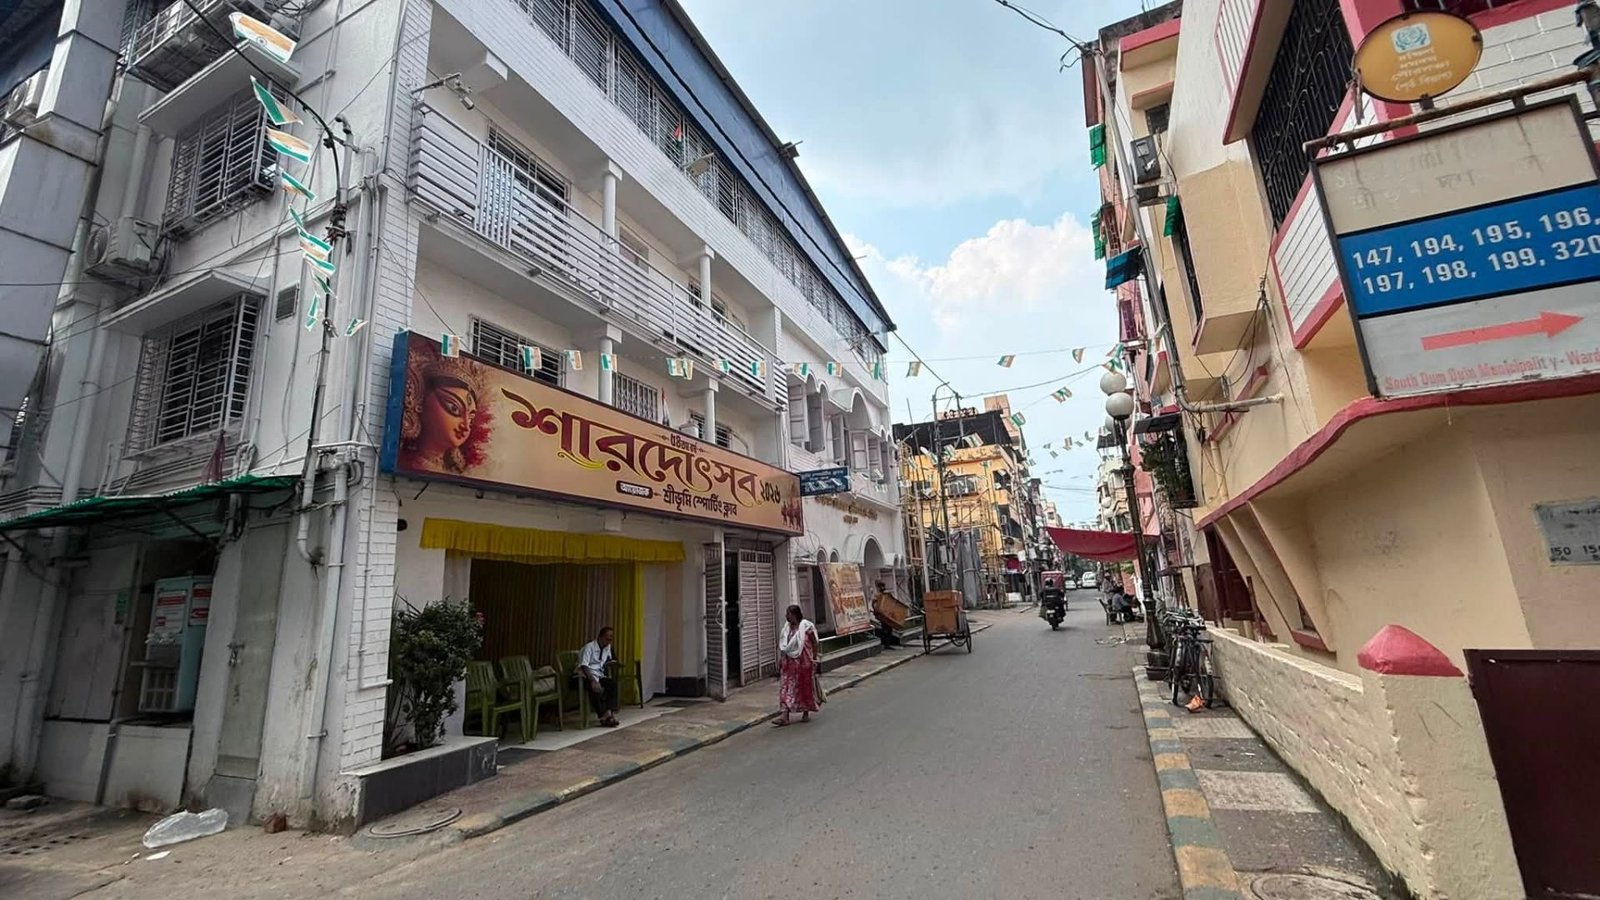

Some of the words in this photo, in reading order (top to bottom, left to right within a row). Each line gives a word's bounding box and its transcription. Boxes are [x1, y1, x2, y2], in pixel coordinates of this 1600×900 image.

[1352, 246, 1403, 270] 147,
[1410, 234, 1464, 258] 194,
[1471, 220, 1532, 246] 195,
[1538, 206, 1600, 233] 196,
[1363, 271, 1414, 295] 197,
[1421, 260, 1477, 285] 198,
[1487, 247, 1546, 272] 199,
[1384, 374, 1419, 391] South
[501, 388, 757, 506] শারদোৎসব
[662, 484, 692, 512] শ্রীভূমি
[723, 501, 738, 518] ক্লাব
[1582, 545, 1600, 555] 15
